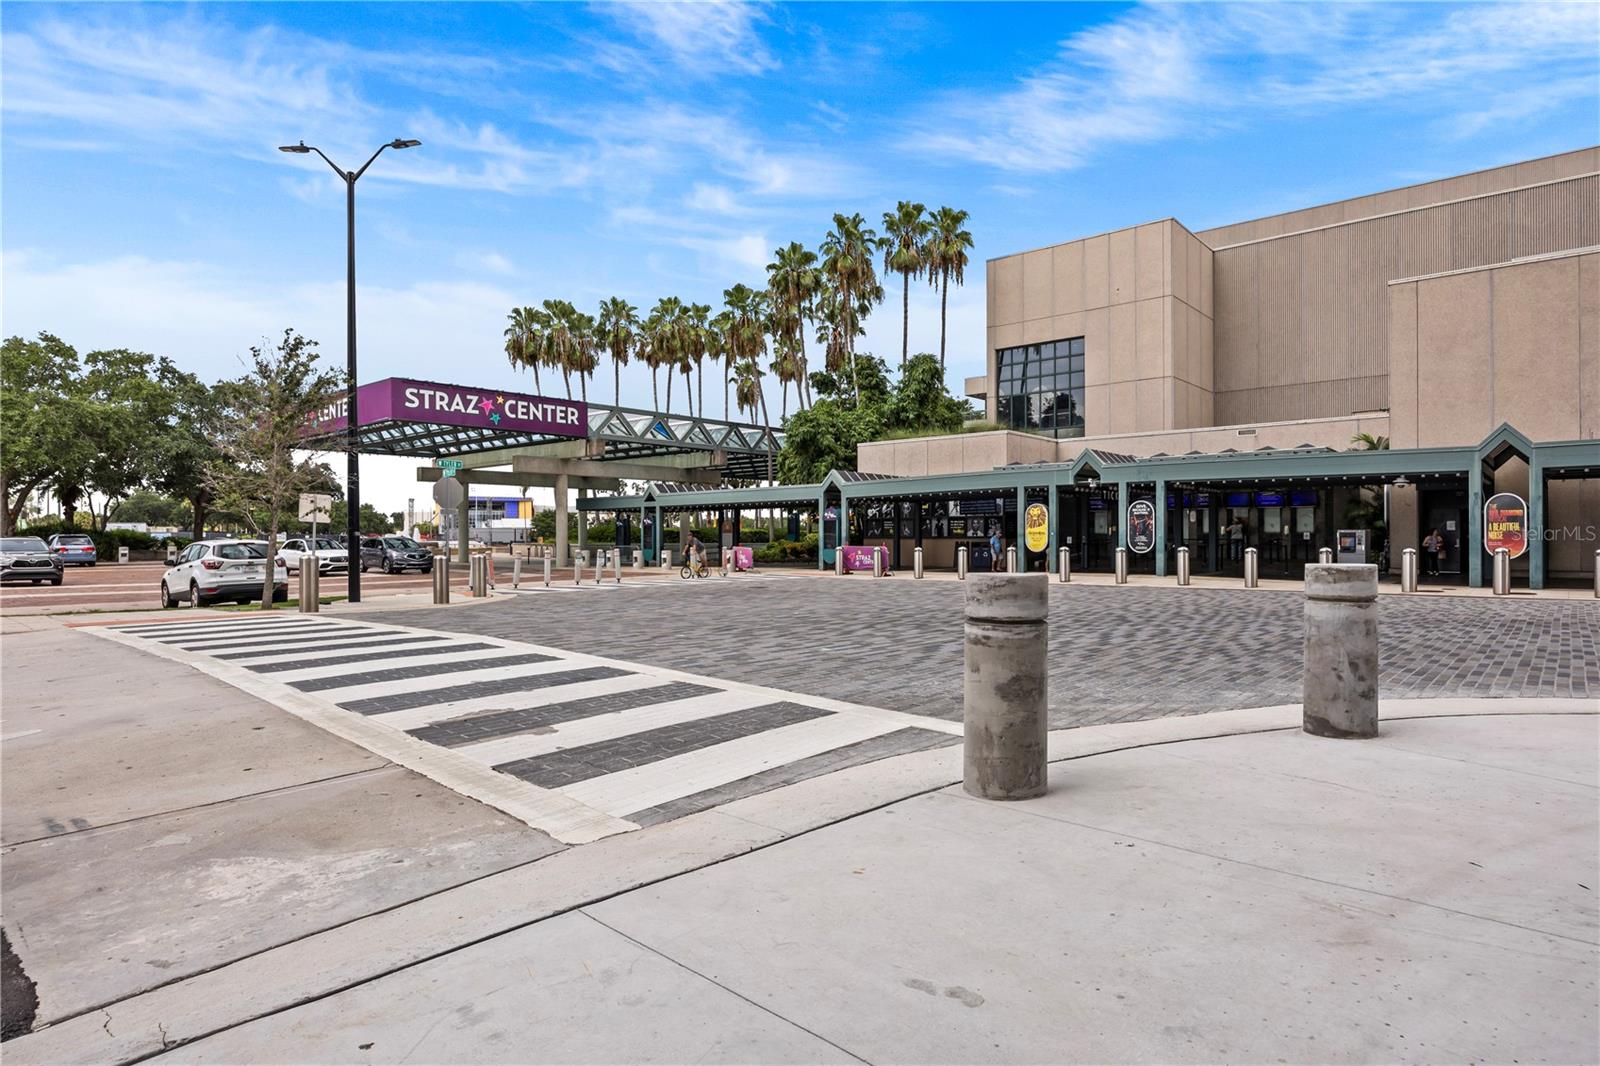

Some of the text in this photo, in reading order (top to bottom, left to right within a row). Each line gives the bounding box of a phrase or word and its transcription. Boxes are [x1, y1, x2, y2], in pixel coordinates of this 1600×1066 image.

[318, 398, 348, 422] CENTE
[404, 388, 580, 425] STRAZ CENTER
[1493, 522, 1520, 532] BEAUTIFUL
